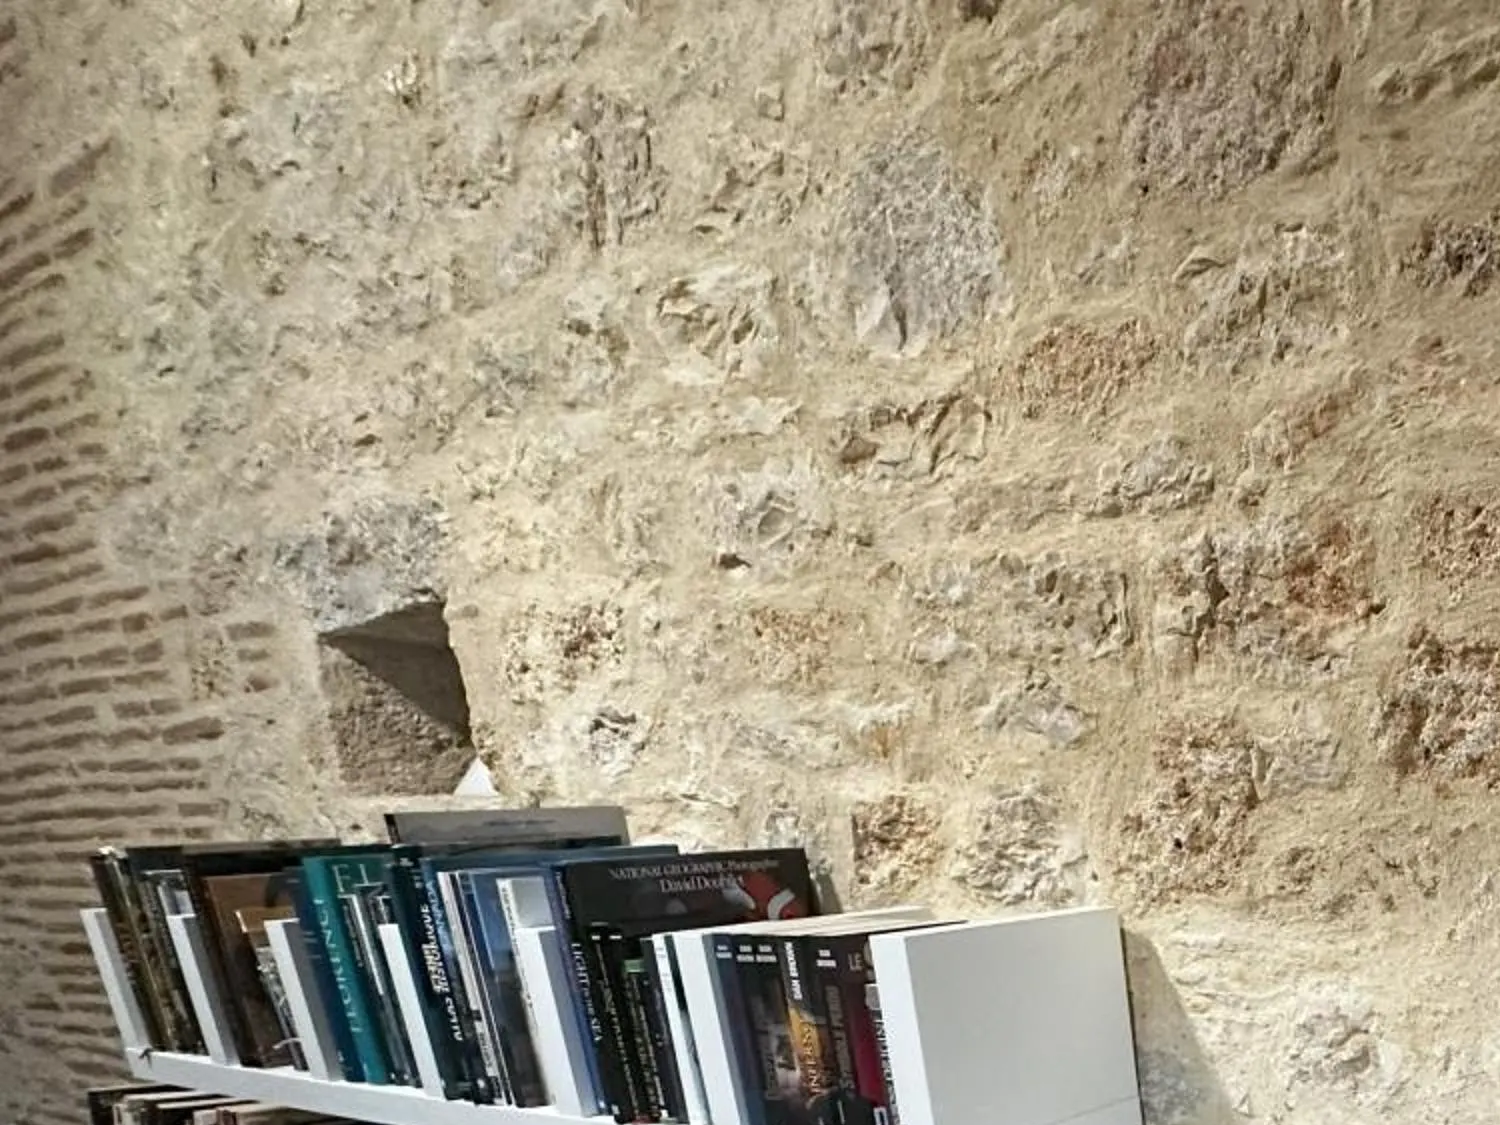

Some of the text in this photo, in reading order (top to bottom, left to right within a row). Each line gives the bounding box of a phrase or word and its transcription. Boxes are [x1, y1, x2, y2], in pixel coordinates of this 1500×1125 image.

[608, 865, 662, 881] NATIONAL
[660, 876, 695, 894] David
[571, 943, 591, 989] LIGHT
[591, 1016, 603, 1042] SEA
